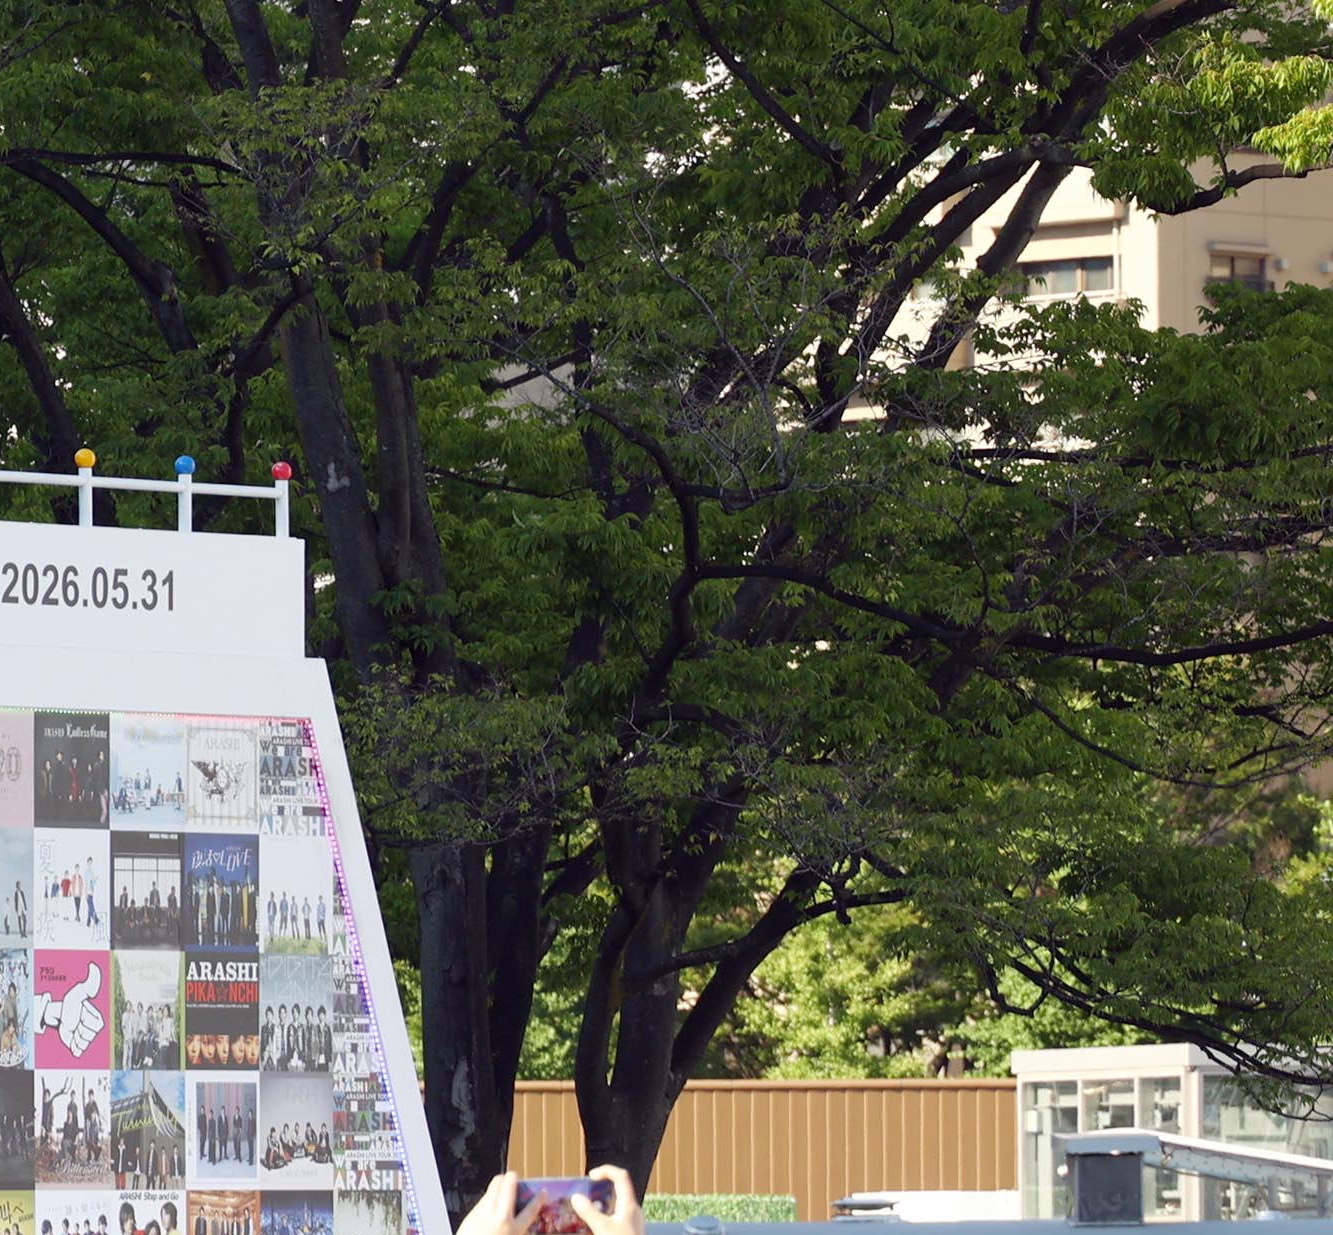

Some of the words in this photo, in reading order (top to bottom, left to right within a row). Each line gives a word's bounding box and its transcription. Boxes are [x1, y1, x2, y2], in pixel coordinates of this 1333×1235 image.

[1, 562, 174, 611] 2026.05.31
[187, 961, 258, 981] ARASHI
[333, 1170, 403, 1190] ARASHI
[158, 1192, 169, 1200] and
[170, 1192, 179, 1200] Go
